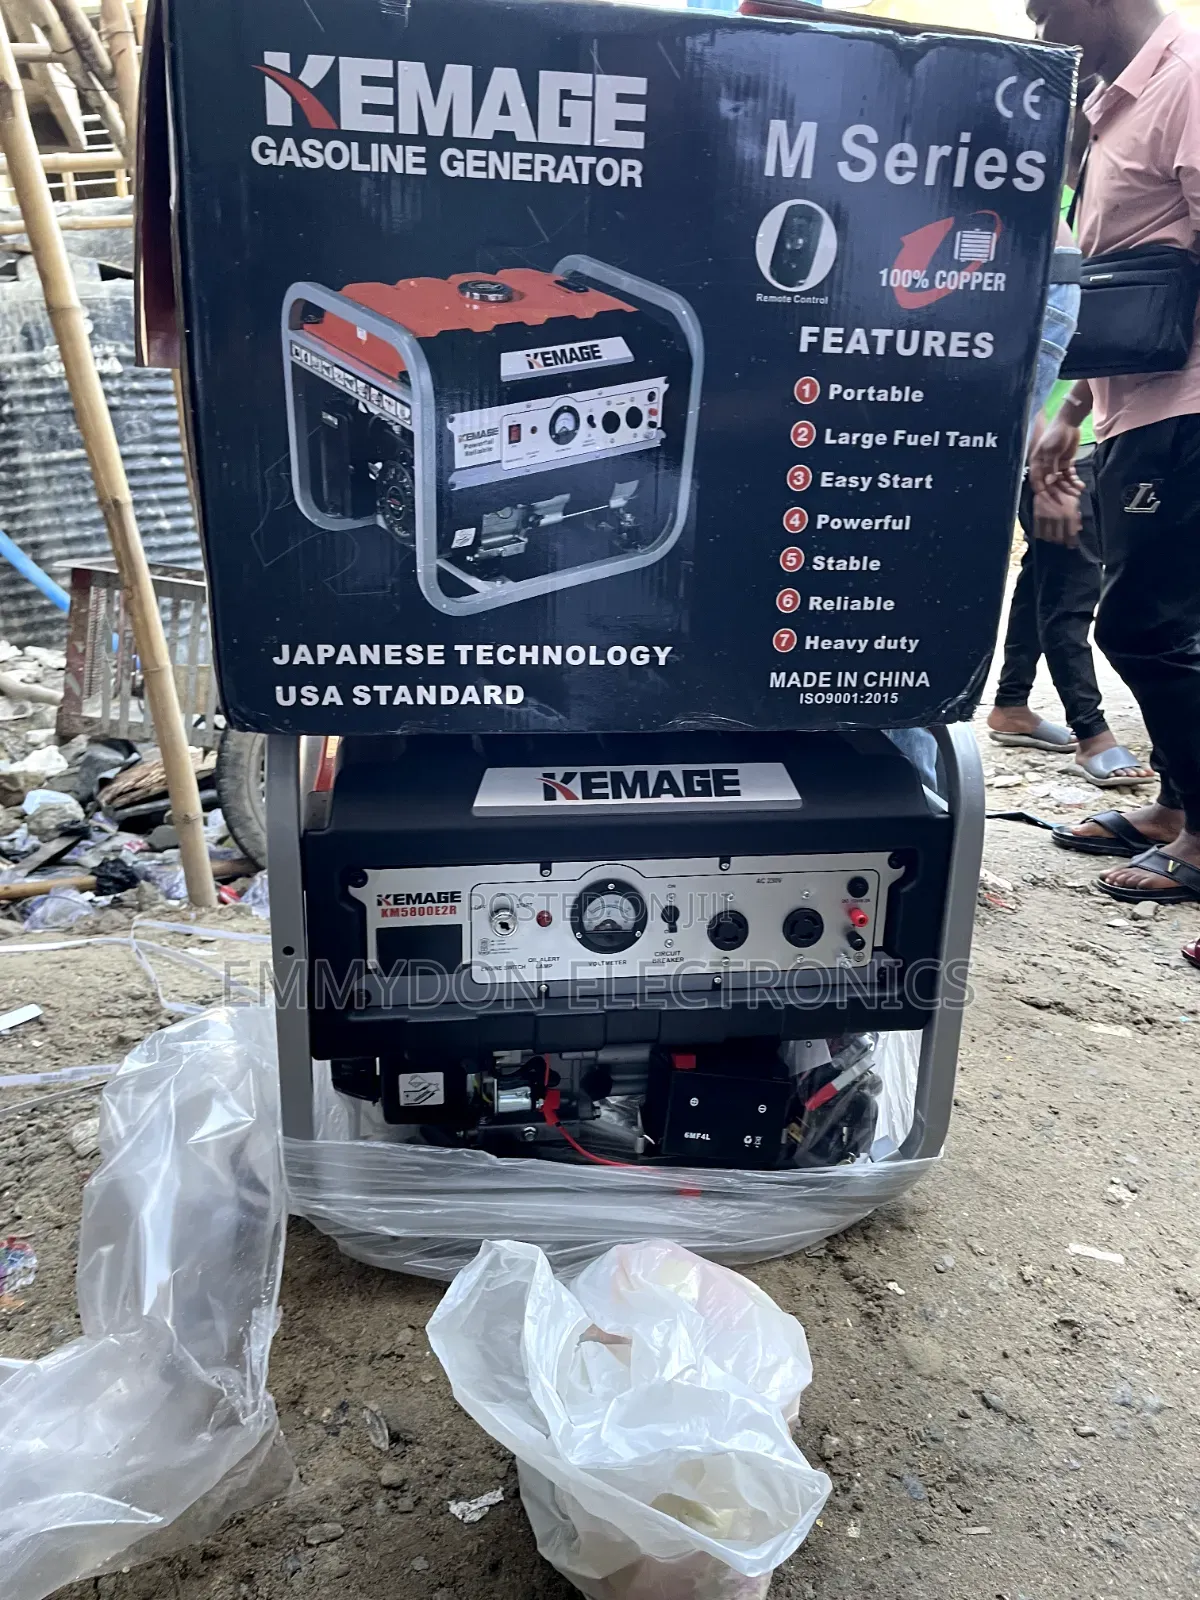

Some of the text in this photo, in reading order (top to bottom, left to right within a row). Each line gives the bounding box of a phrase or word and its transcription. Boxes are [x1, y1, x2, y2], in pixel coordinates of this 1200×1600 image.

[252, 51, 647, 149] KEMAGE
[251, 135, 643, 187] GASOLINE GENERATOR
[764, 119, 1047, 192] M Series
[879, 267, 1007, 292] 100% COPPER
[756, 292, 829, 305] Remote Control
[799, 326, 995, 359] FEATURES
[525, 343, 604, 370] KEMAGE
[828, 383, 925, 403] Portable
[824, 428, 888, 449] Large
[893, 429, 940, 446] Fuel
[946, 431, 998, 448] Tank
[820, 471, 873, 491] Easy
[877, 472, 934, 489] Start
[816, 514, 912, 530] Powerful
[812, 555, 881, 571] Stable
[808, 596, 896, 611] Reliable
[804, 635, 869, 653] Heavy
[873, 635, 920, 654] duty
[272, 644, 674, 666] JAPANESE TECHNOLOGY
[769, 672, 931, 688] MADE IN CHINA
[275, 685, 525, 706] USA STANDARD
[799, 692, 899, 704] ISO9001:2015
[534, 768, 741, 801] KEMAGE
[376, 891, 462, 906] KEMAGE
[380, 904, 458, 919] KM5800E2R
[588, 959, 628, 967] VOLTMETER
